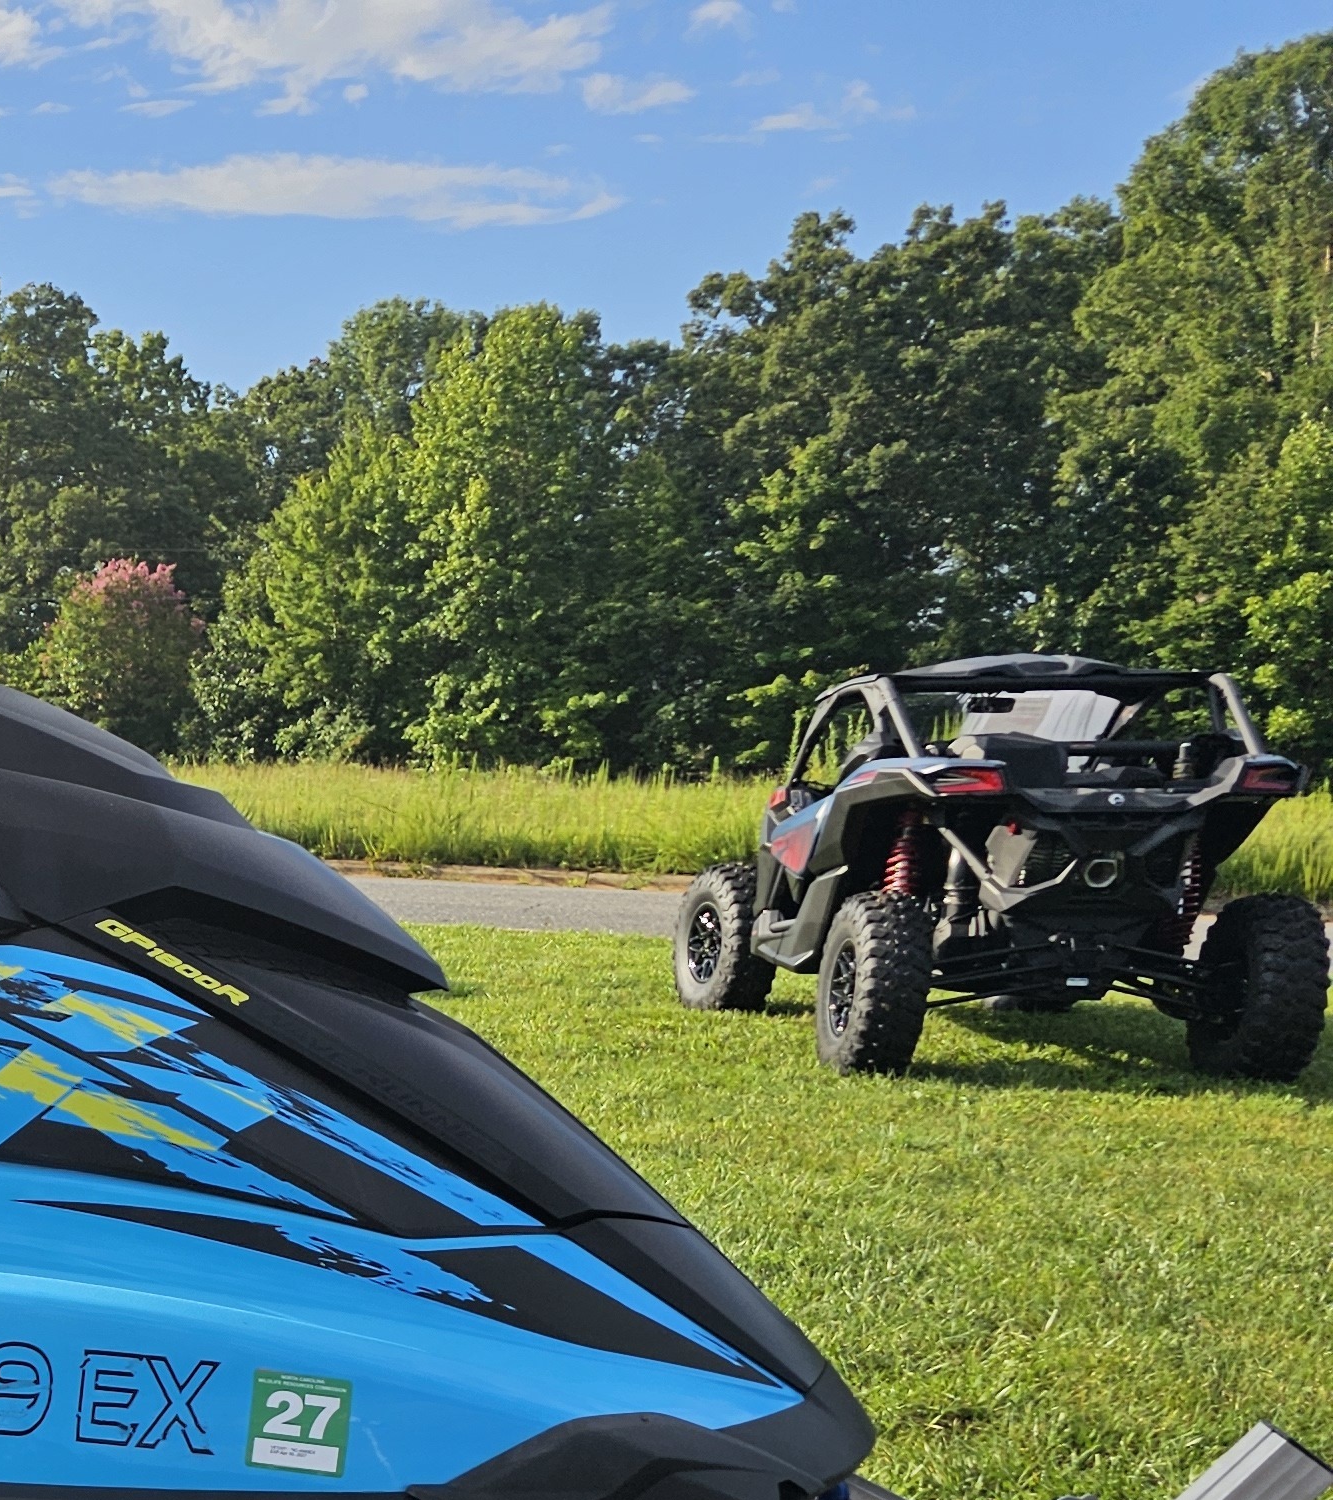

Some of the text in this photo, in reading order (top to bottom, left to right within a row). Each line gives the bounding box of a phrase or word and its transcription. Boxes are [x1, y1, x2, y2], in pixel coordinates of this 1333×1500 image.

[94, 918, 250, 1007] GP1800R
[75, 1348, 222, 1456] EX
[262, 1389, 341, 1440] 27
